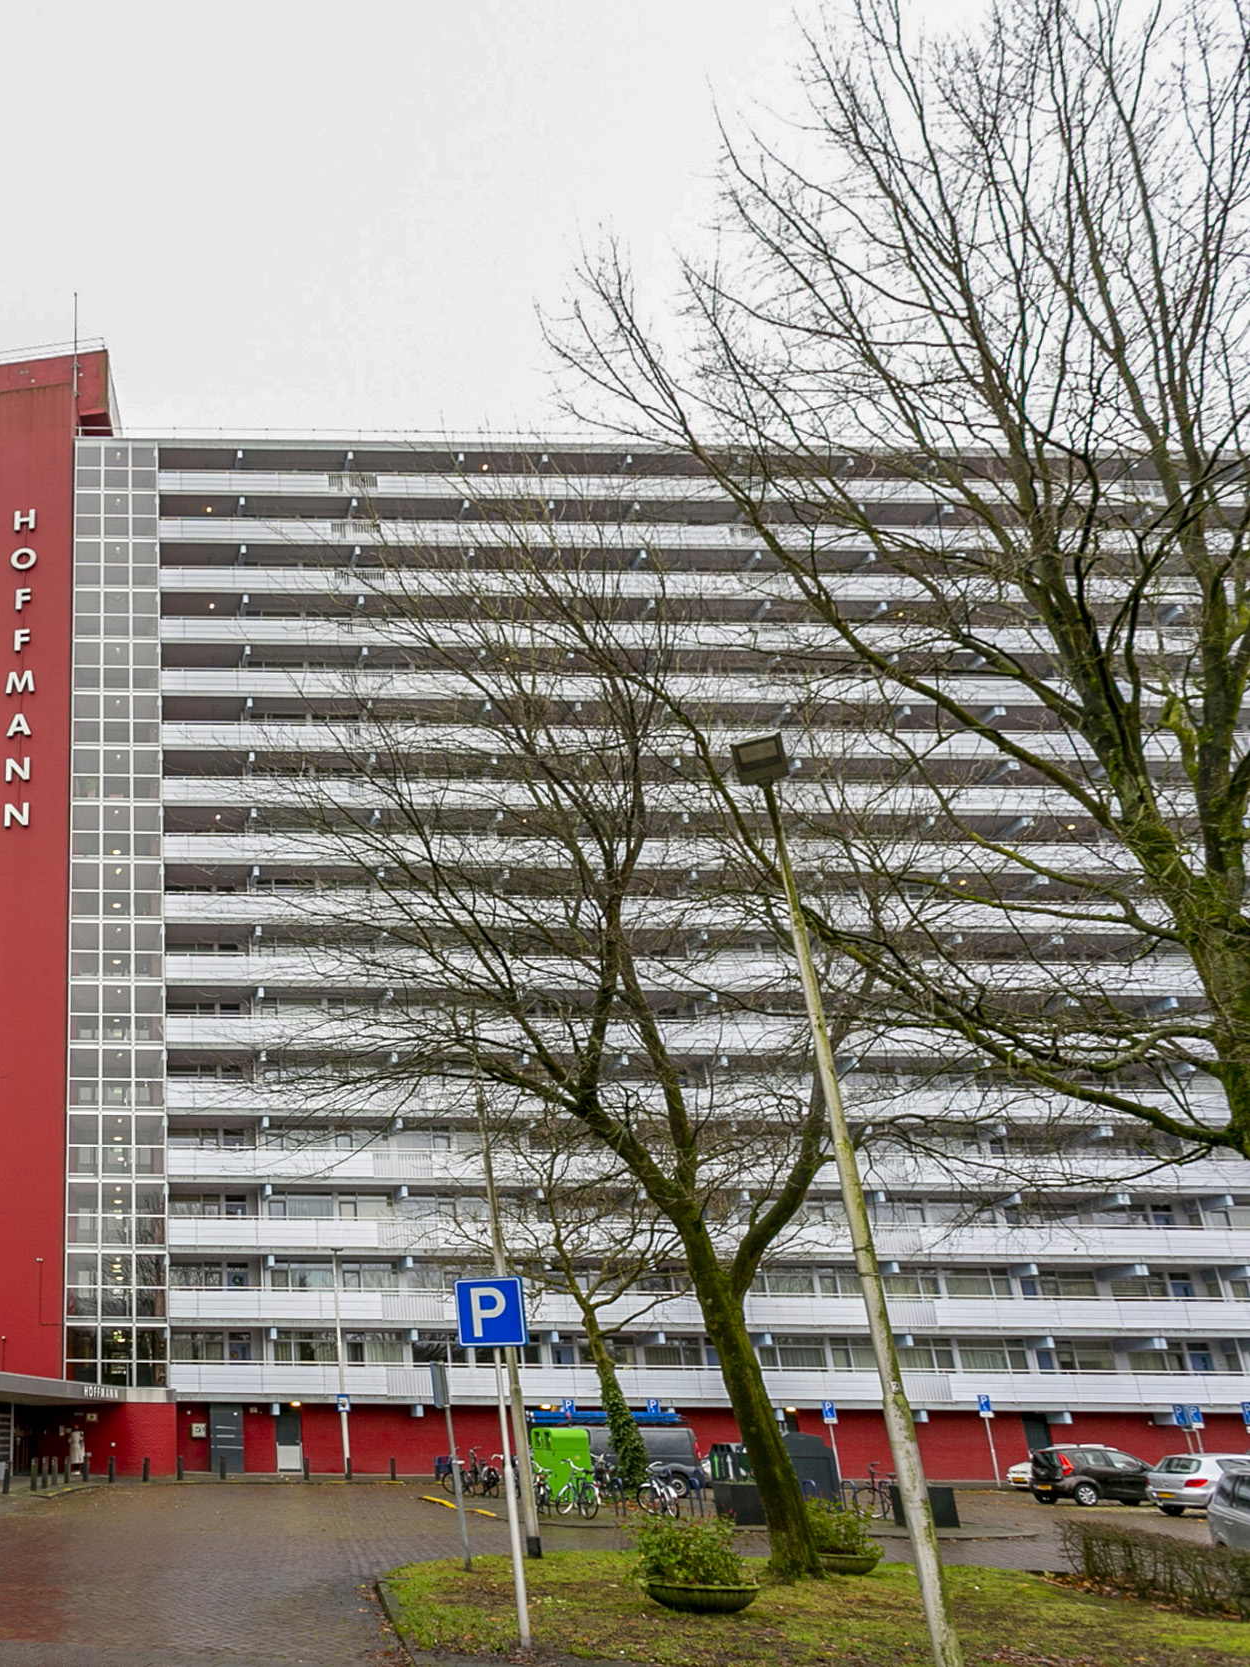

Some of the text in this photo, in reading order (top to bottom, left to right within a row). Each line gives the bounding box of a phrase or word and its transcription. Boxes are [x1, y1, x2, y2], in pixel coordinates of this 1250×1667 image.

[4, 508, 37, 828] HOFFMANN
[470, 1287, 506, 1337] P
[83, 1386, 119, 1399] HOFFMANN
[565, 1400, 572, 1410] P
[650, 1400, 657, 1410] P
